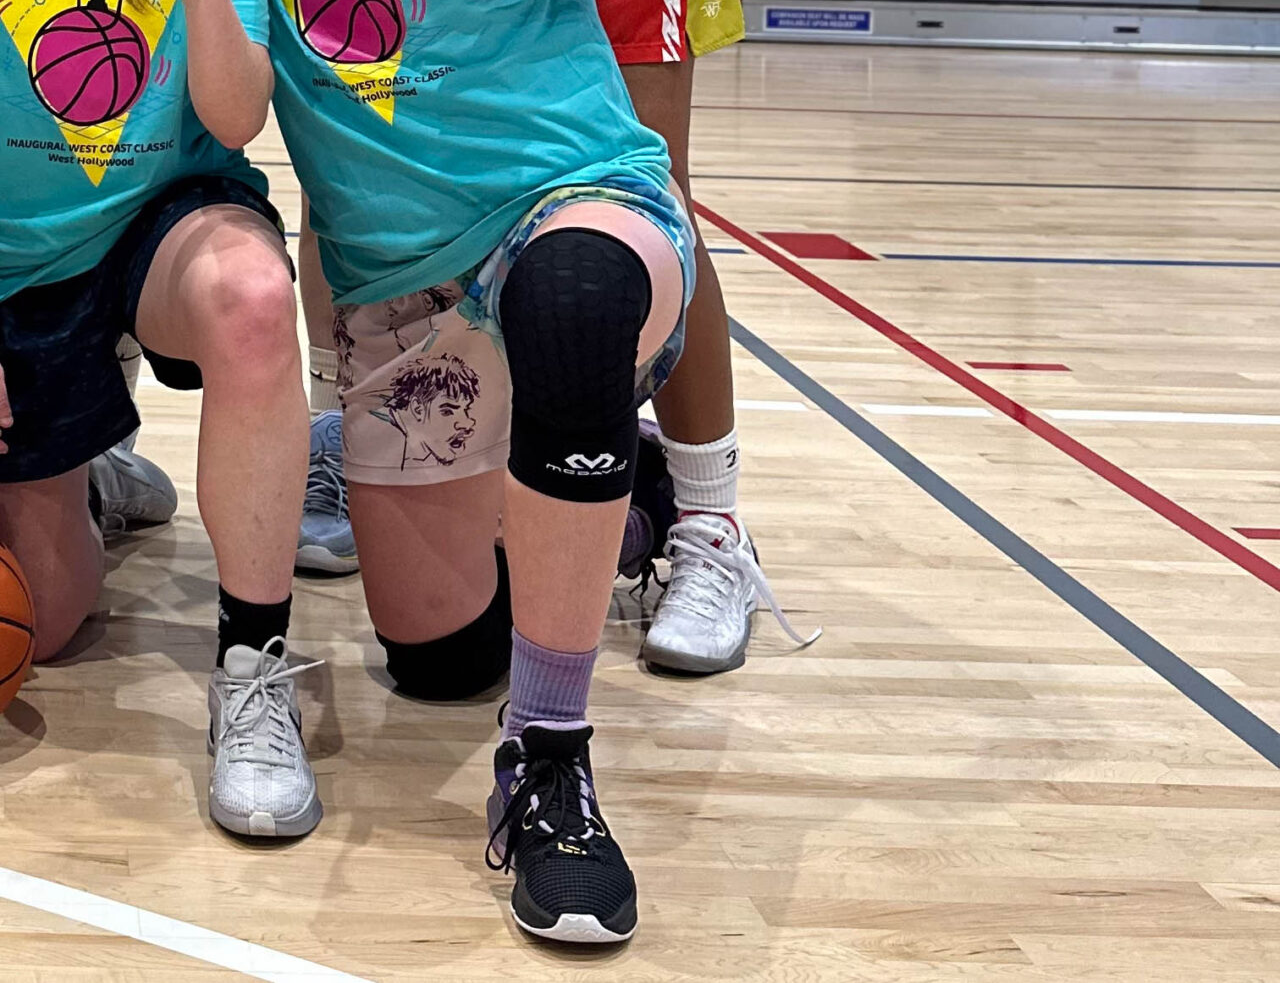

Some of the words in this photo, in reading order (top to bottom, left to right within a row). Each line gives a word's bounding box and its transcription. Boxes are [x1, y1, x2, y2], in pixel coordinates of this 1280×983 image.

[349, 79, 377, 93] WEST
[378, 76, 411, 87] COAST
[415, 66, 456, 83] CLASSIC
[361, 87, 418, 104] Hollywood
[7, 138, 66, 151] INAUGURAL
[68, 143, 97, 153] WEST
[100, 143, 132, 153] COAST
[134, 139, 174, 153] CLASSIC
[48, 153, 74, 164] West
[77, 154, 135, 166] Hollywood
